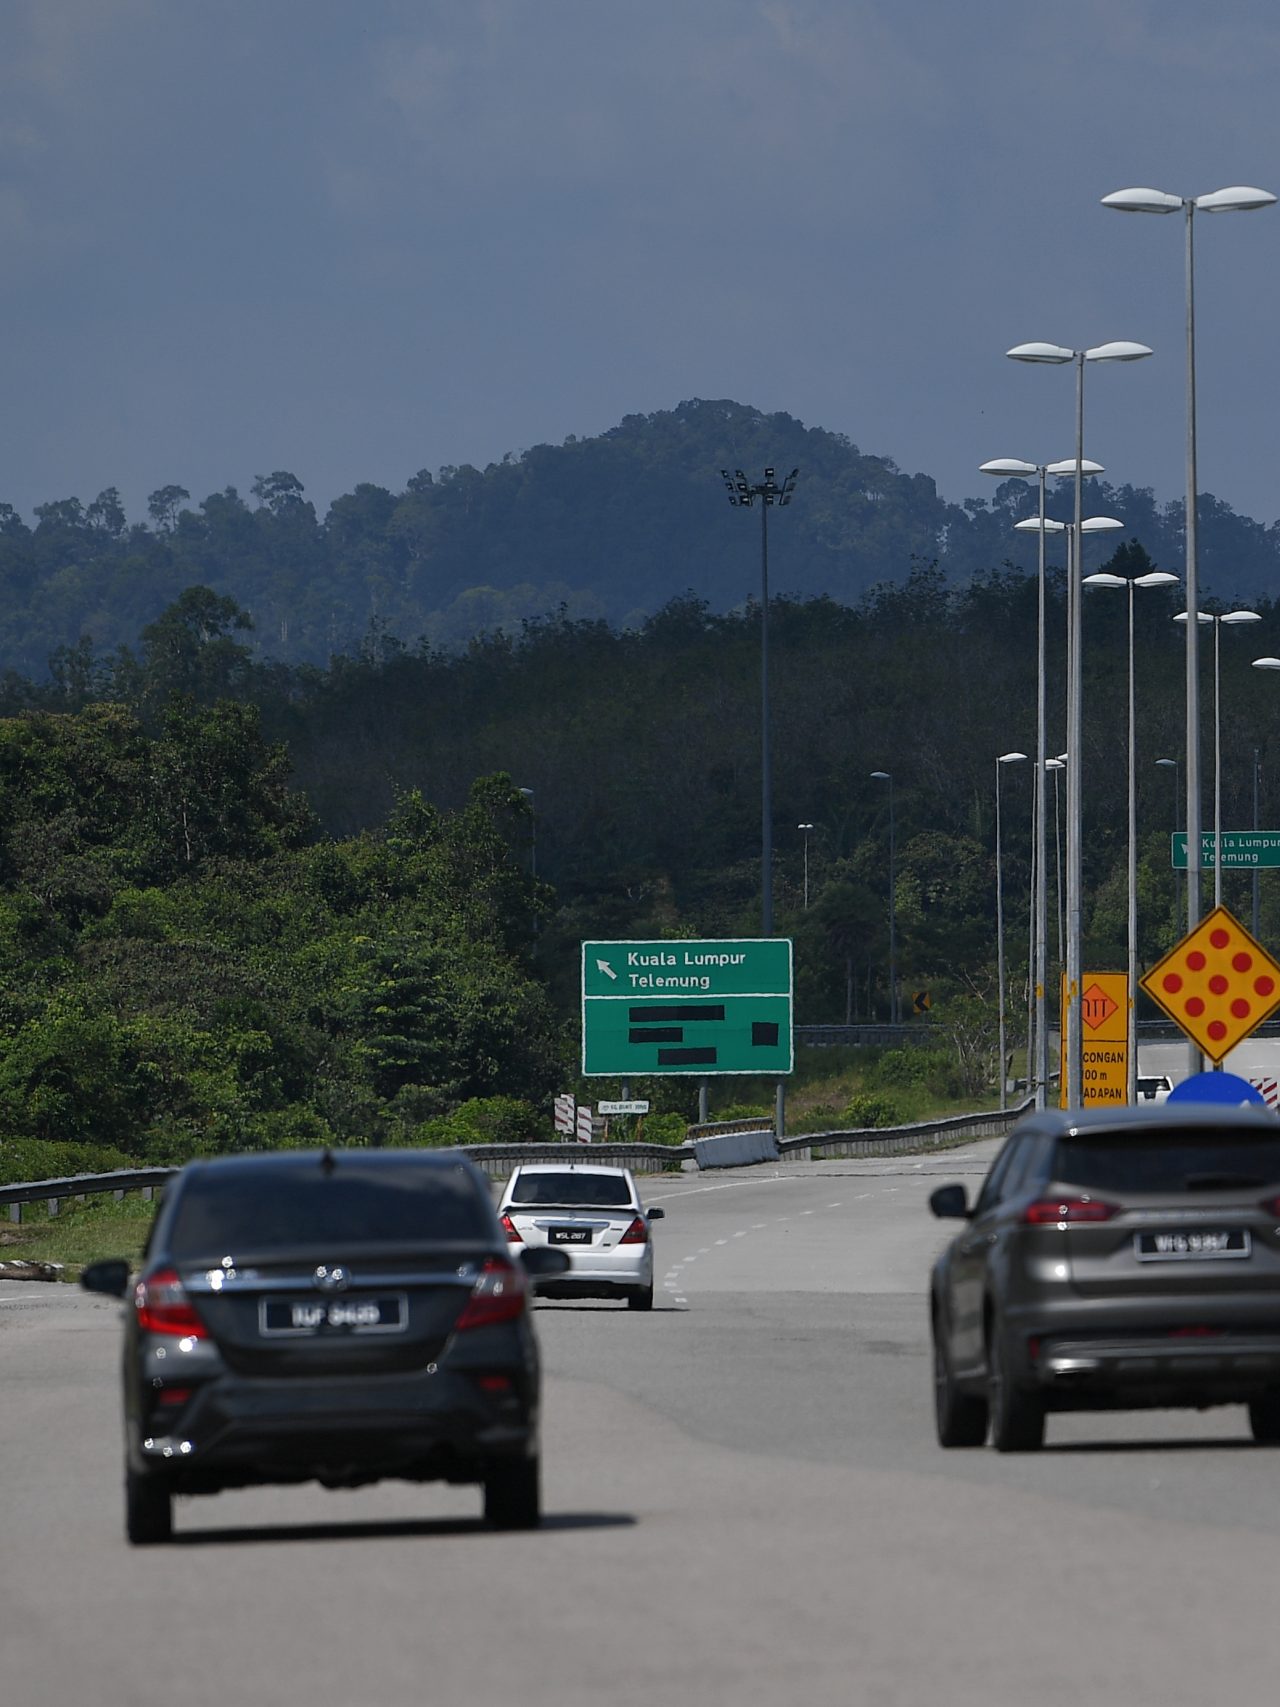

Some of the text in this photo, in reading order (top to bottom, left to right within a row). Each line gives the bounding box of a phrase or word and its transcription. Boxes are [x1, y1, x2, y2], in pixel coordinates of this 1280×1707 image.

[1202, 838, 1235, 848] Kula
[1203, 852, 1259, 863] Teemung
[627, 951, 746, 967] Kuala Lumpur
[629, 974, 710, 990] Telemung
[1065, 1052, 1124, 1063] CONGAN
[1080, 1087, 1122, 1099] ADAPAN
